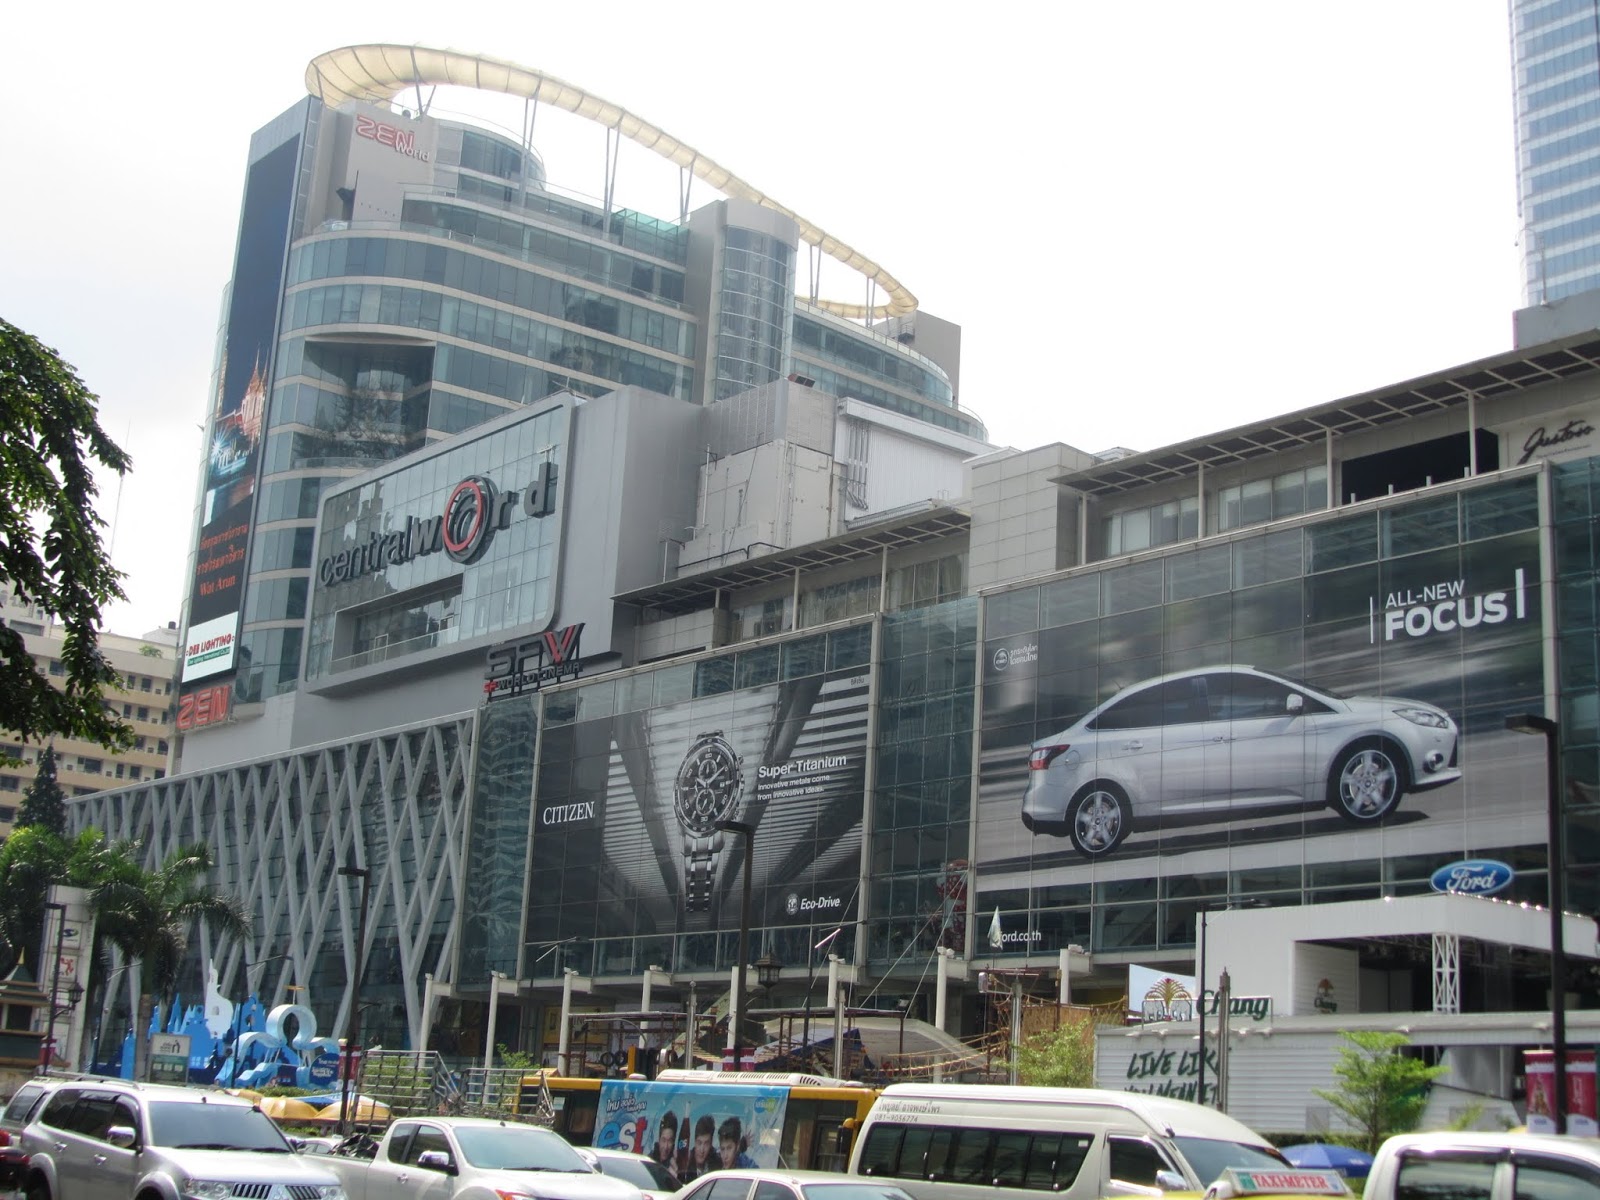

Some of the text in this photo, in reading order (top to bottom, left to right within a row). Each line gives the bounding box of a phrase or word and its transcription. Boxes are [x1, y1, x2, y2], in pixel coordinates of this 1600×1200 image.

[356, 114, 414, 151] ZEN
[395, 142, 430, 162] World
[200, 576, 236, 596] Wat Arun
[1385, 579, 1465, 609] ALL-NEW
[1385, 592, 1508, 641] FOCUS
[201, 633, 232, 653] LIGHTING
[498, 673, 535, 690] WORLD
[539, 662, 582, 680] CINEMA
[176, 685, 230, 729] ZEN
[758, 756, 847, 778] Super Titanium
[757, 774, 831, 791] Innovative metals come
[757, 793, 772, 801] from
[773, 788, 804, 799] innovative
[543, 801, 594, 825] CITIZEN
[1446, 865, 1497, 890] Ford
[800, 896, 840, 910] Eco-Drive
[1000, 930, 1042, 942] ord.co.th
[1126, 1047, 1230, 1078] LIVE LIK
[1252, 1174, 1328, 1189] TAXI-METER
